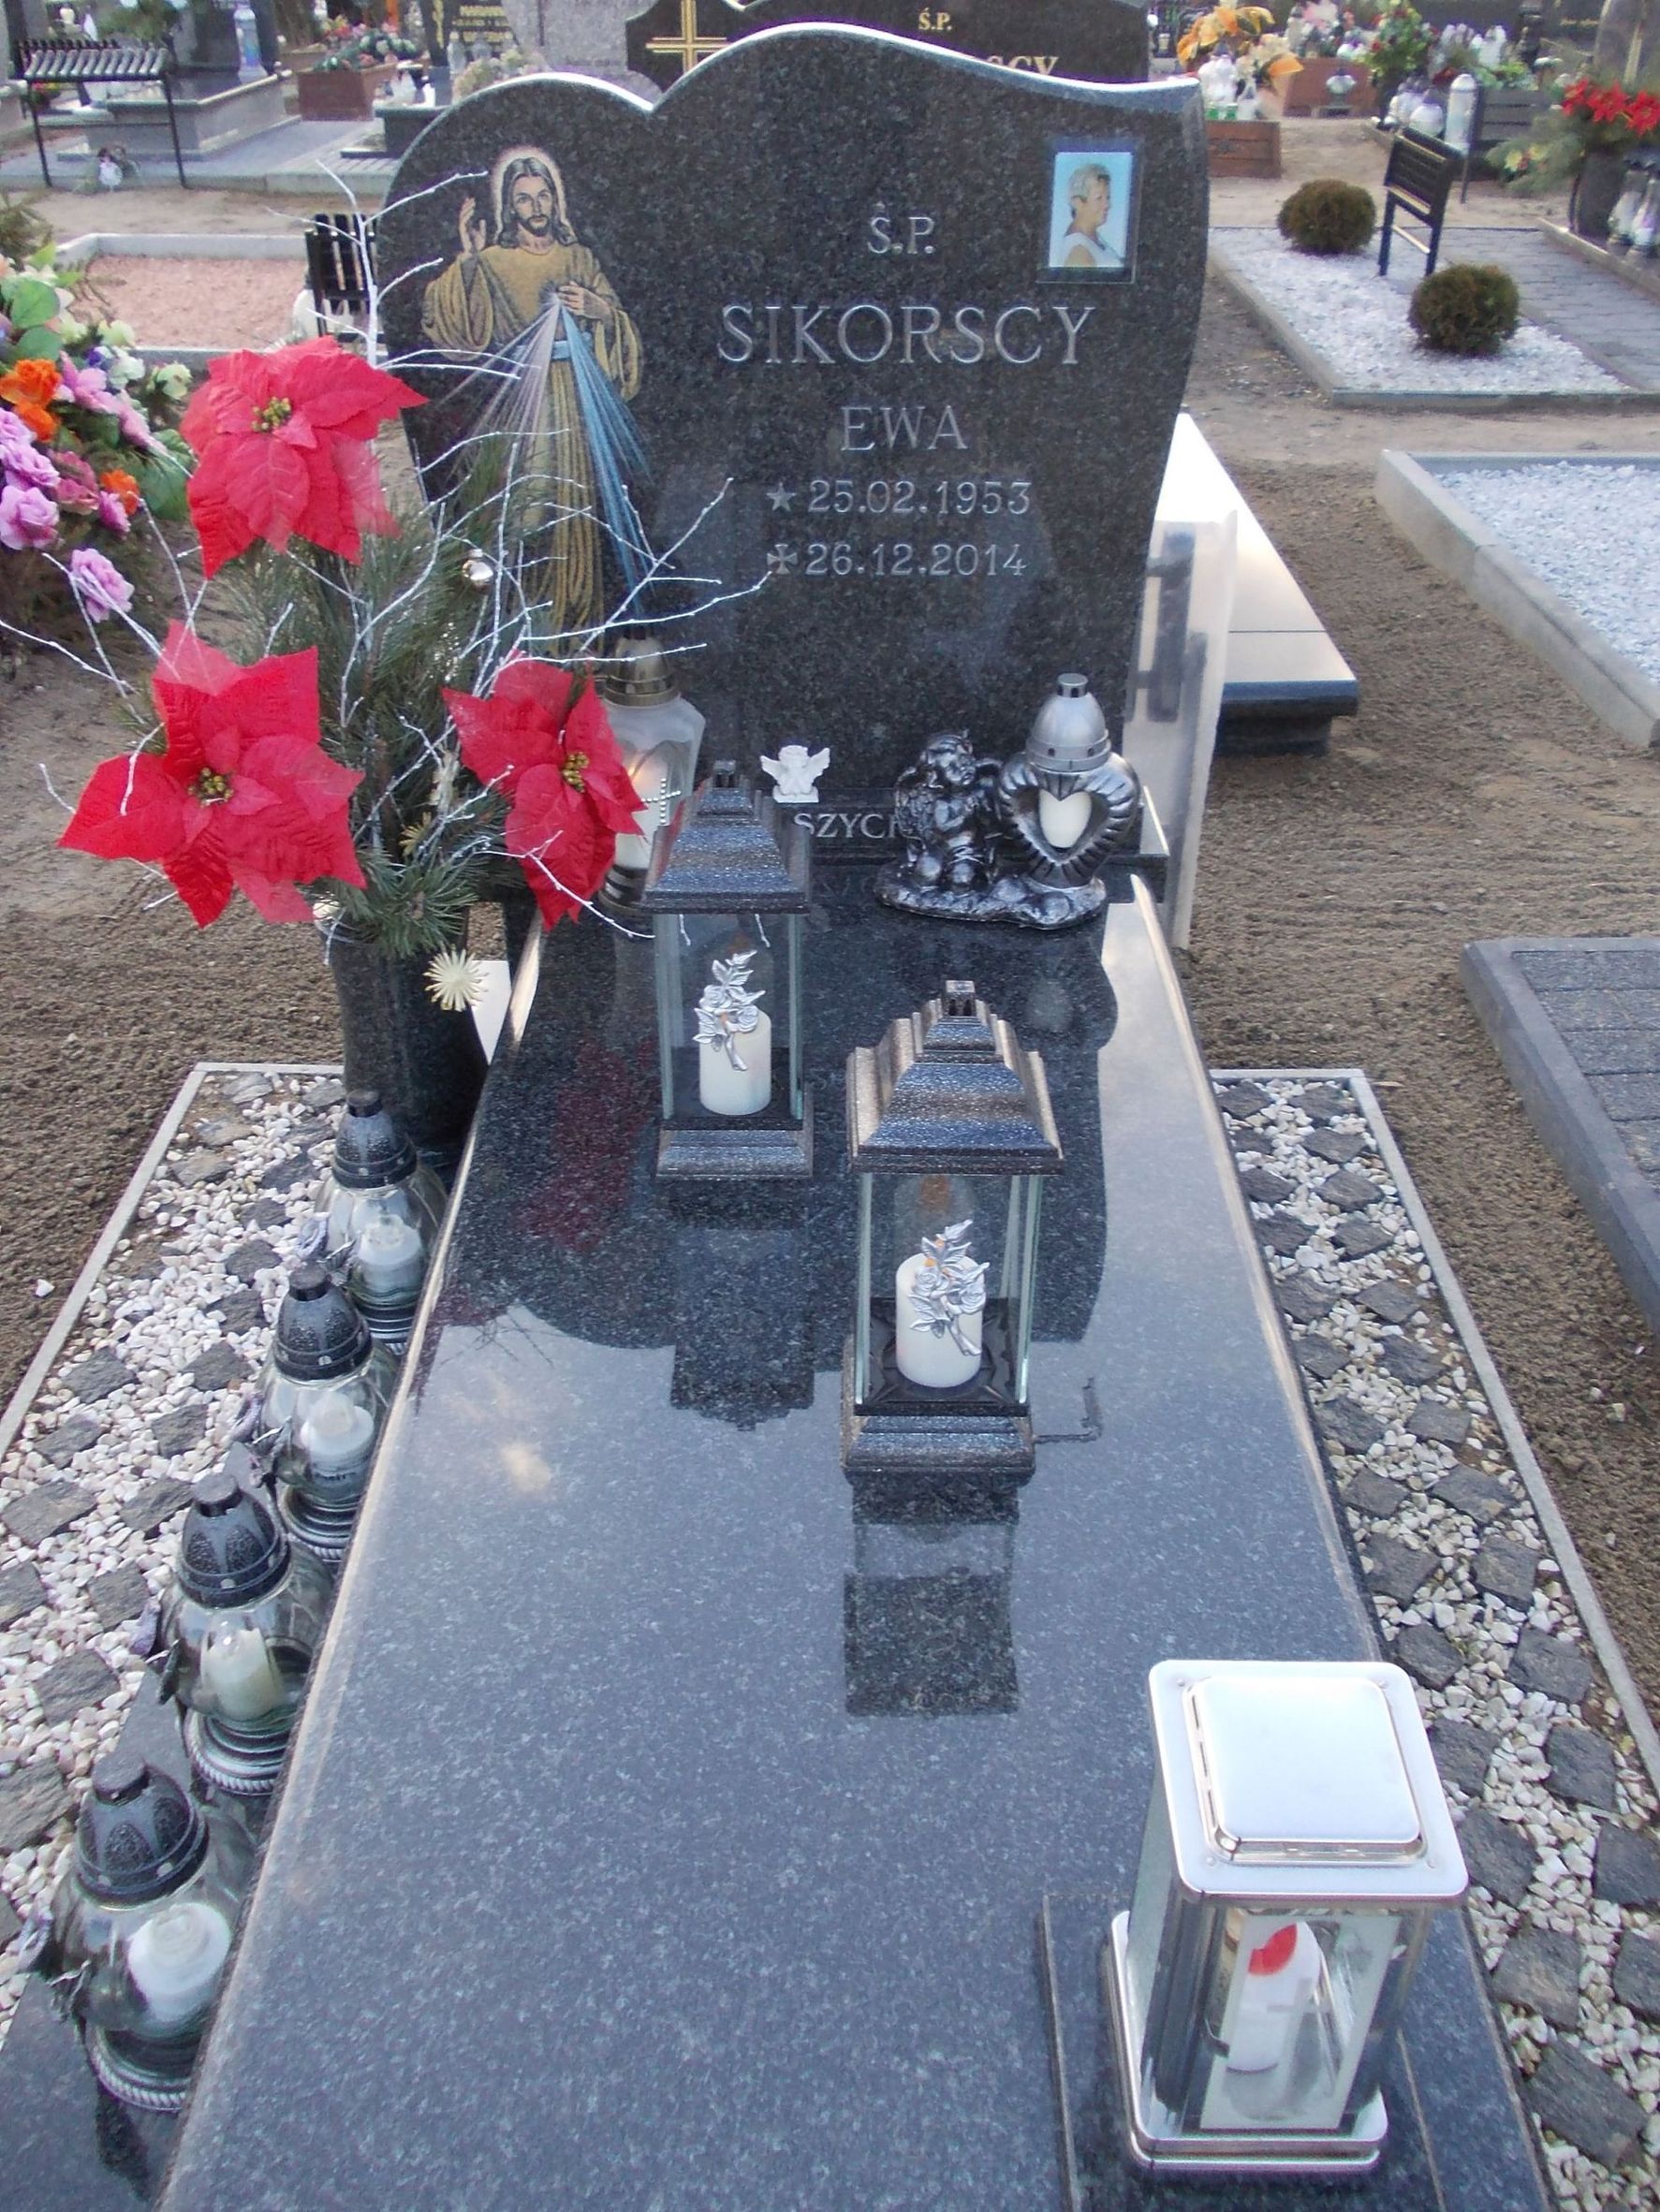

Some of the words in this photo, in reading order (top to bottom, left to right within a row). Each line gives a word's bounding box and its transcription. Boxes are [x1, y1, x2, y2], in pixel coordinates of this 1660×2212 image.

[918, 7, 952, 31] Ś.P.
[867, 200, 936, 255] Ś.P.
[716, 303, 1095, 364] SIKORSCY
[840, 403, 968, 451] EWA
[807, 478, 1032, 515] 25.02.1953
[804, 542, 1027, 577] 26.12.2014
